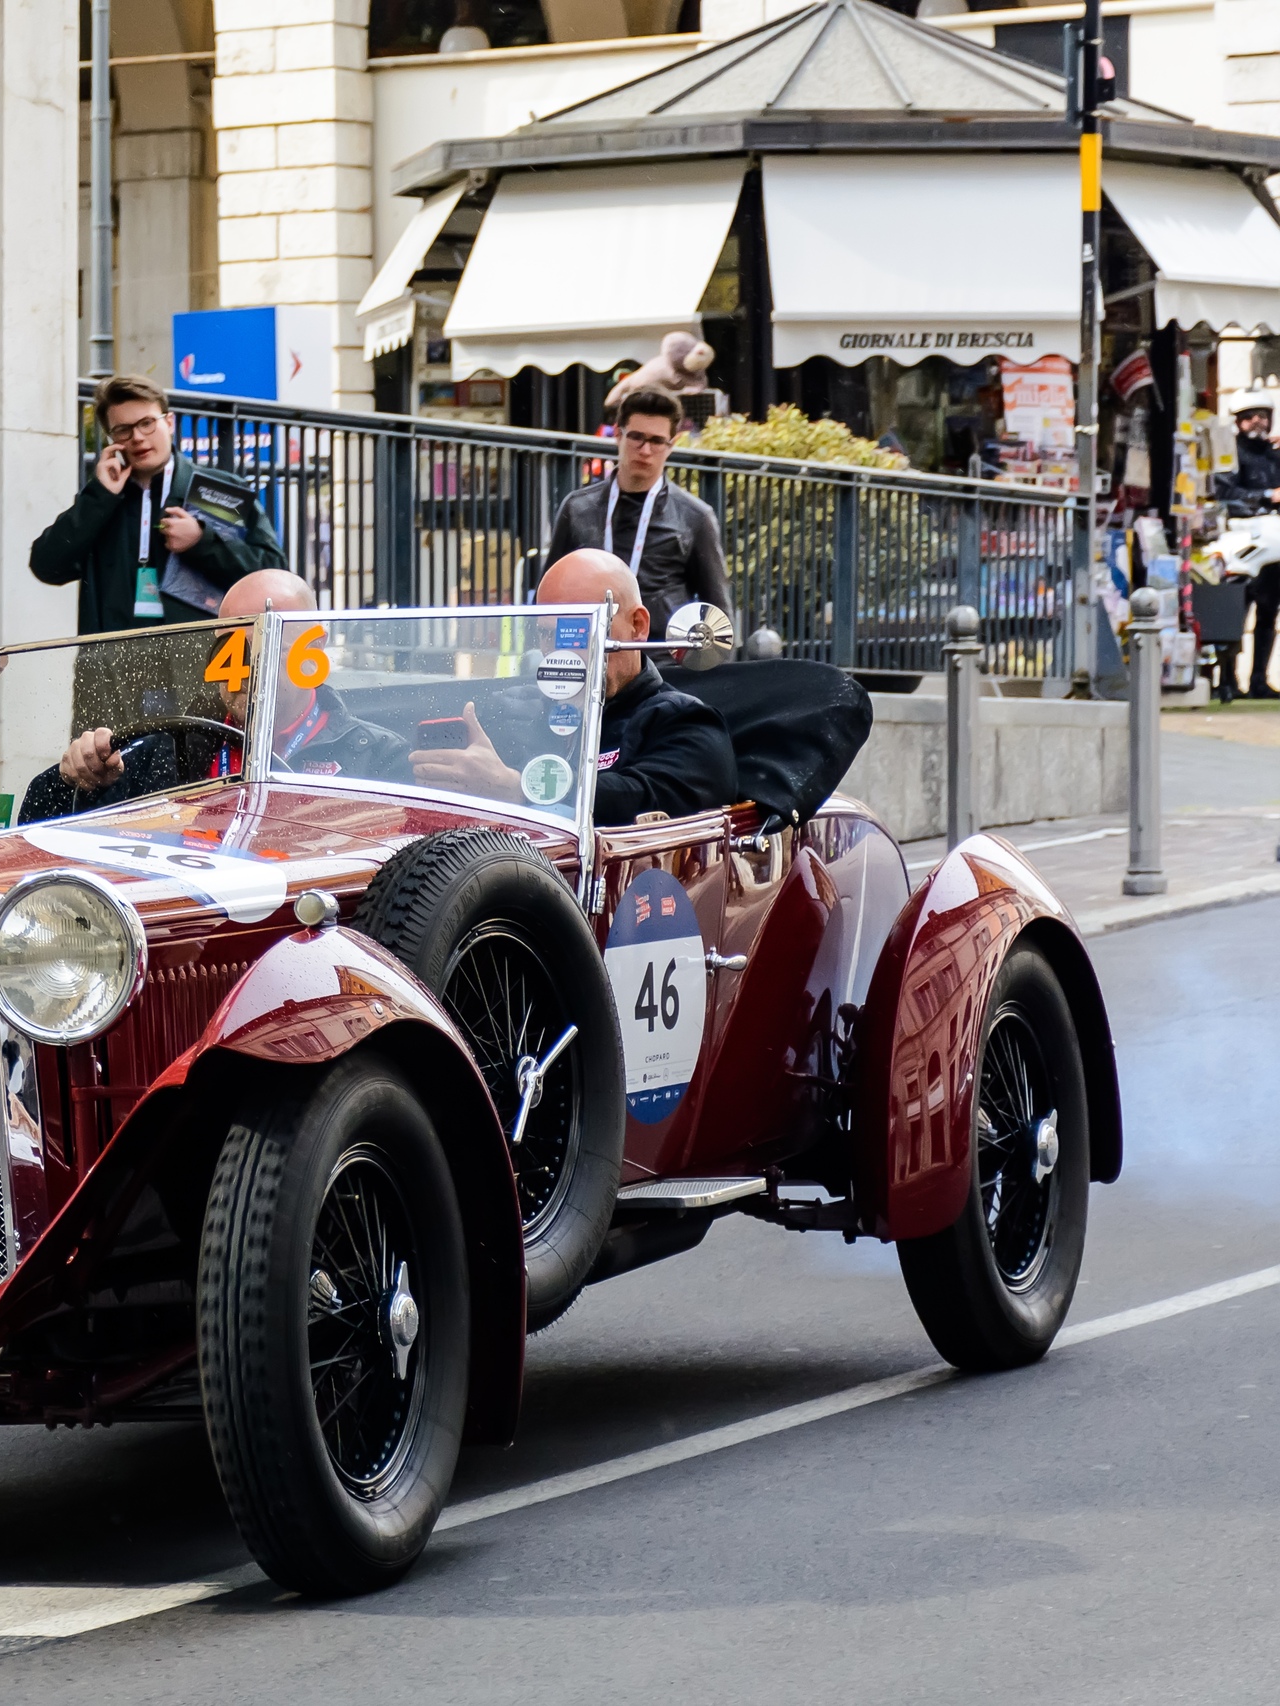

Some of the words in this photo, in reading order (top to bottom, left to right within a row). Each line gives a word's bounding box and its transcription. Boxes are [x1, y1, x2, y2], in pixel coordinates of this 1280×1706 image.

[839, 333, 931, 349] GIORNALE
[934, 333, 957, 348] DI
[956, 332, 1035, 348] BRESCIA
[546, 658, 581, 666] VERIFICATO
[99, 845, 216, 870] 46
[635, 957, 679, 1033] 46
